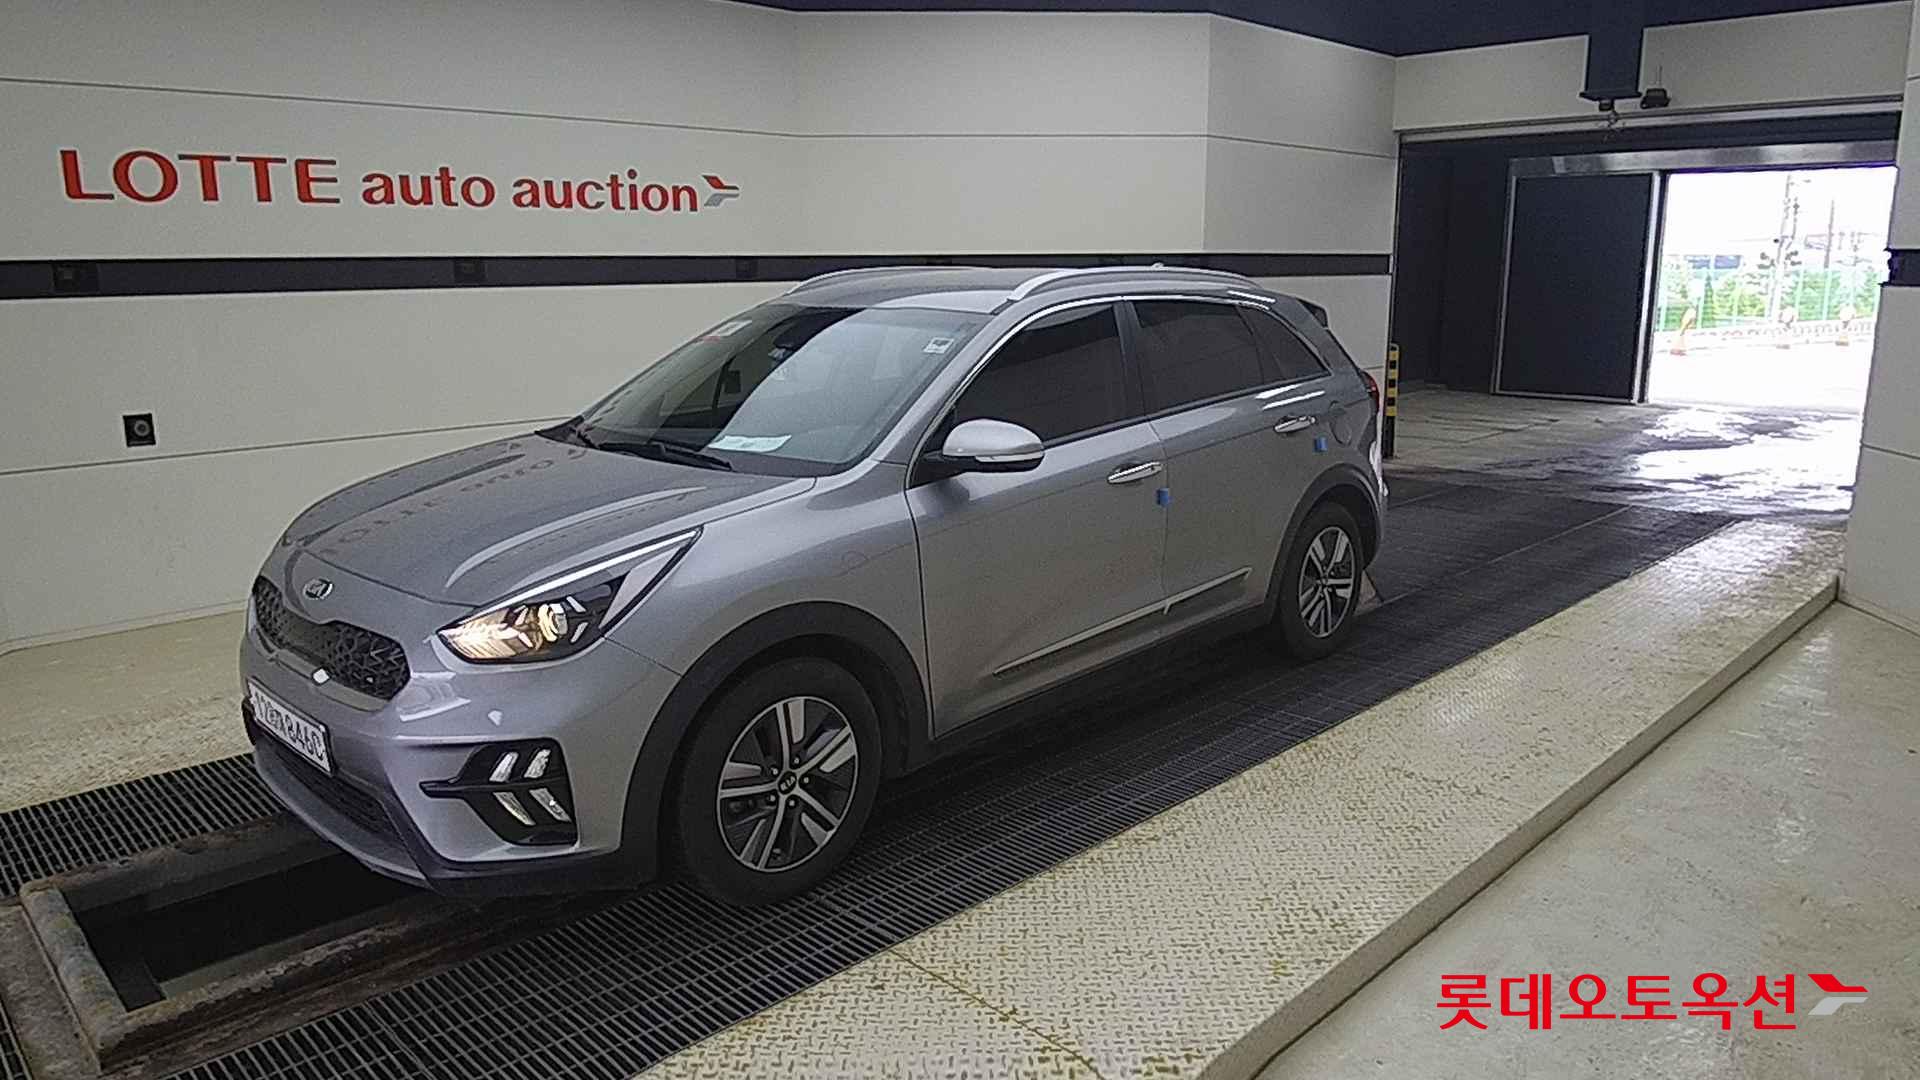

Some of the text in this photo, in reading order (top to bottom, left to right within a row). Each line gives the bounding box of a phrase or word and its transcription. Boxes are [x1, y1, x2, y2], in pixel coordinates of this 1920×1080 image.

[60, 149, 699, 213] LOTTE auto auction
